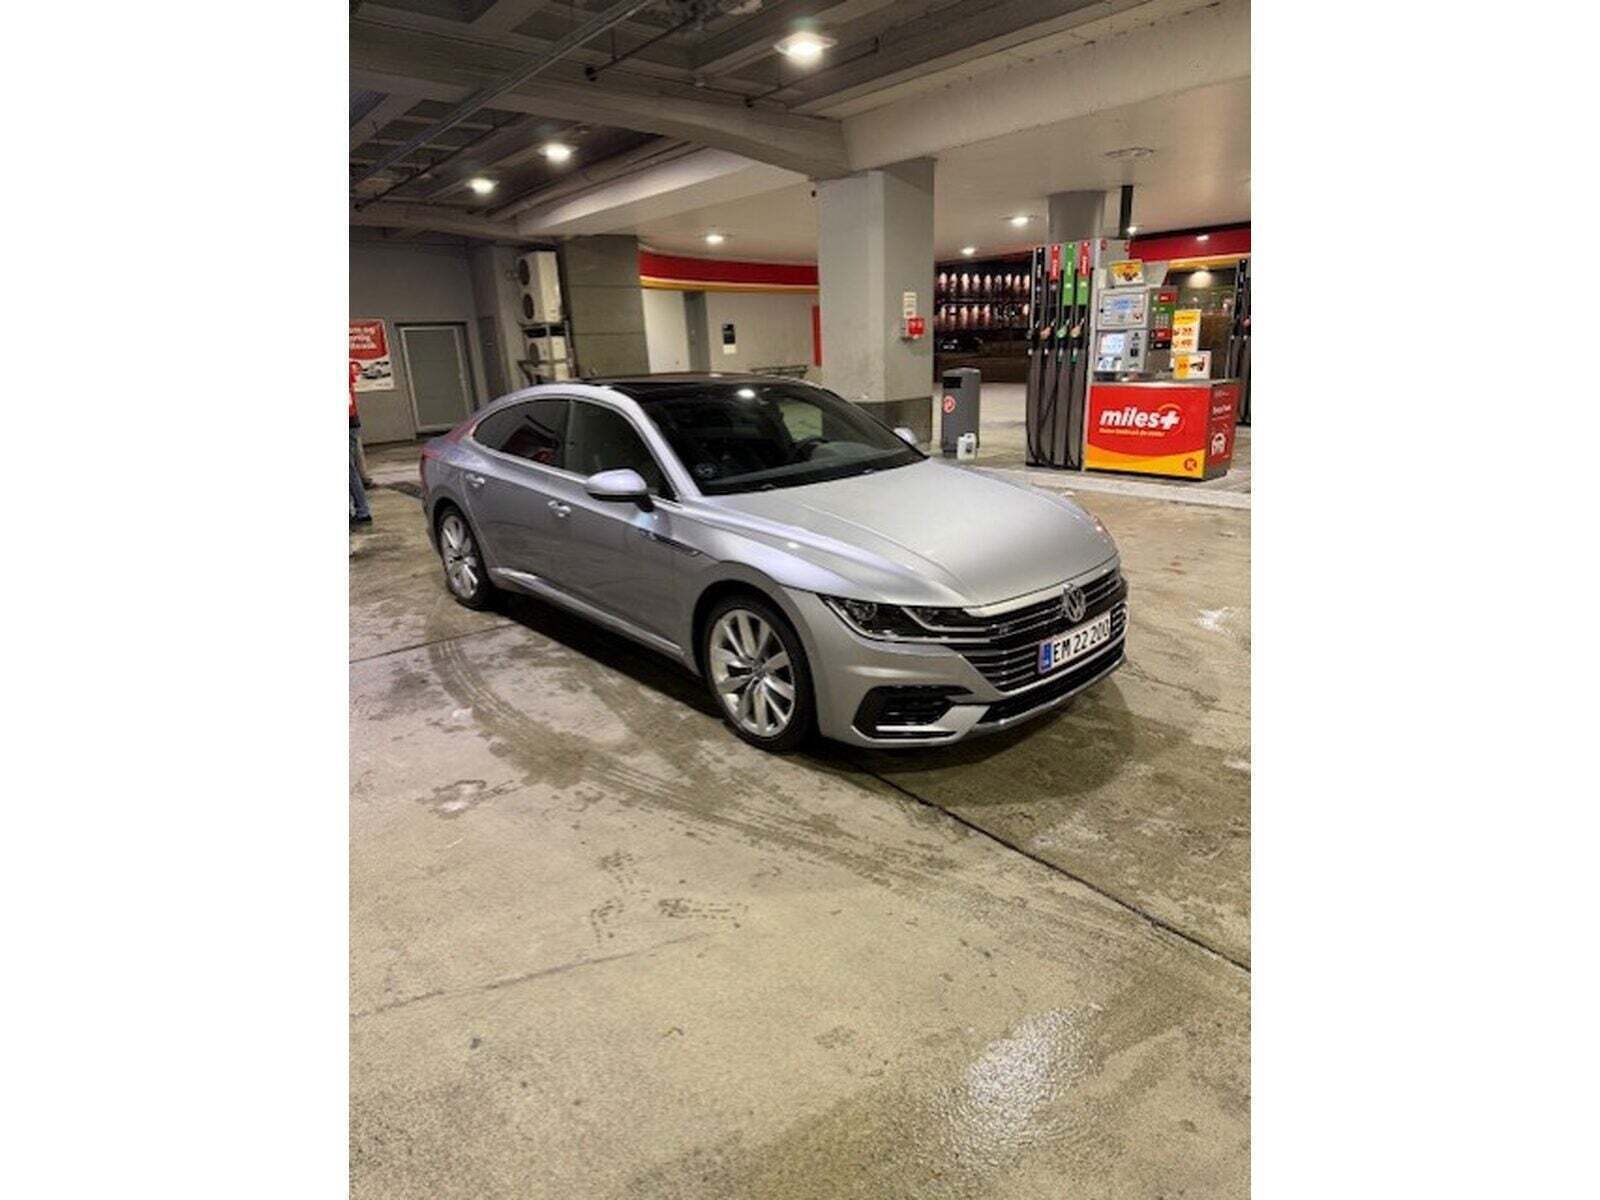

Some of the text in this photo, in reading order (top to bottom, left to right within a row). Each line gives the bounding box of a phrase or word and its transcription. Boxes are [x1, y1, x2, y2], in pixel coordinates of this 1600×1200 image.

[1099, 406, 1181, 430] miles+
[1053, 638, 1071, 663] EM
[1074, 630, 1089, 654] 22
